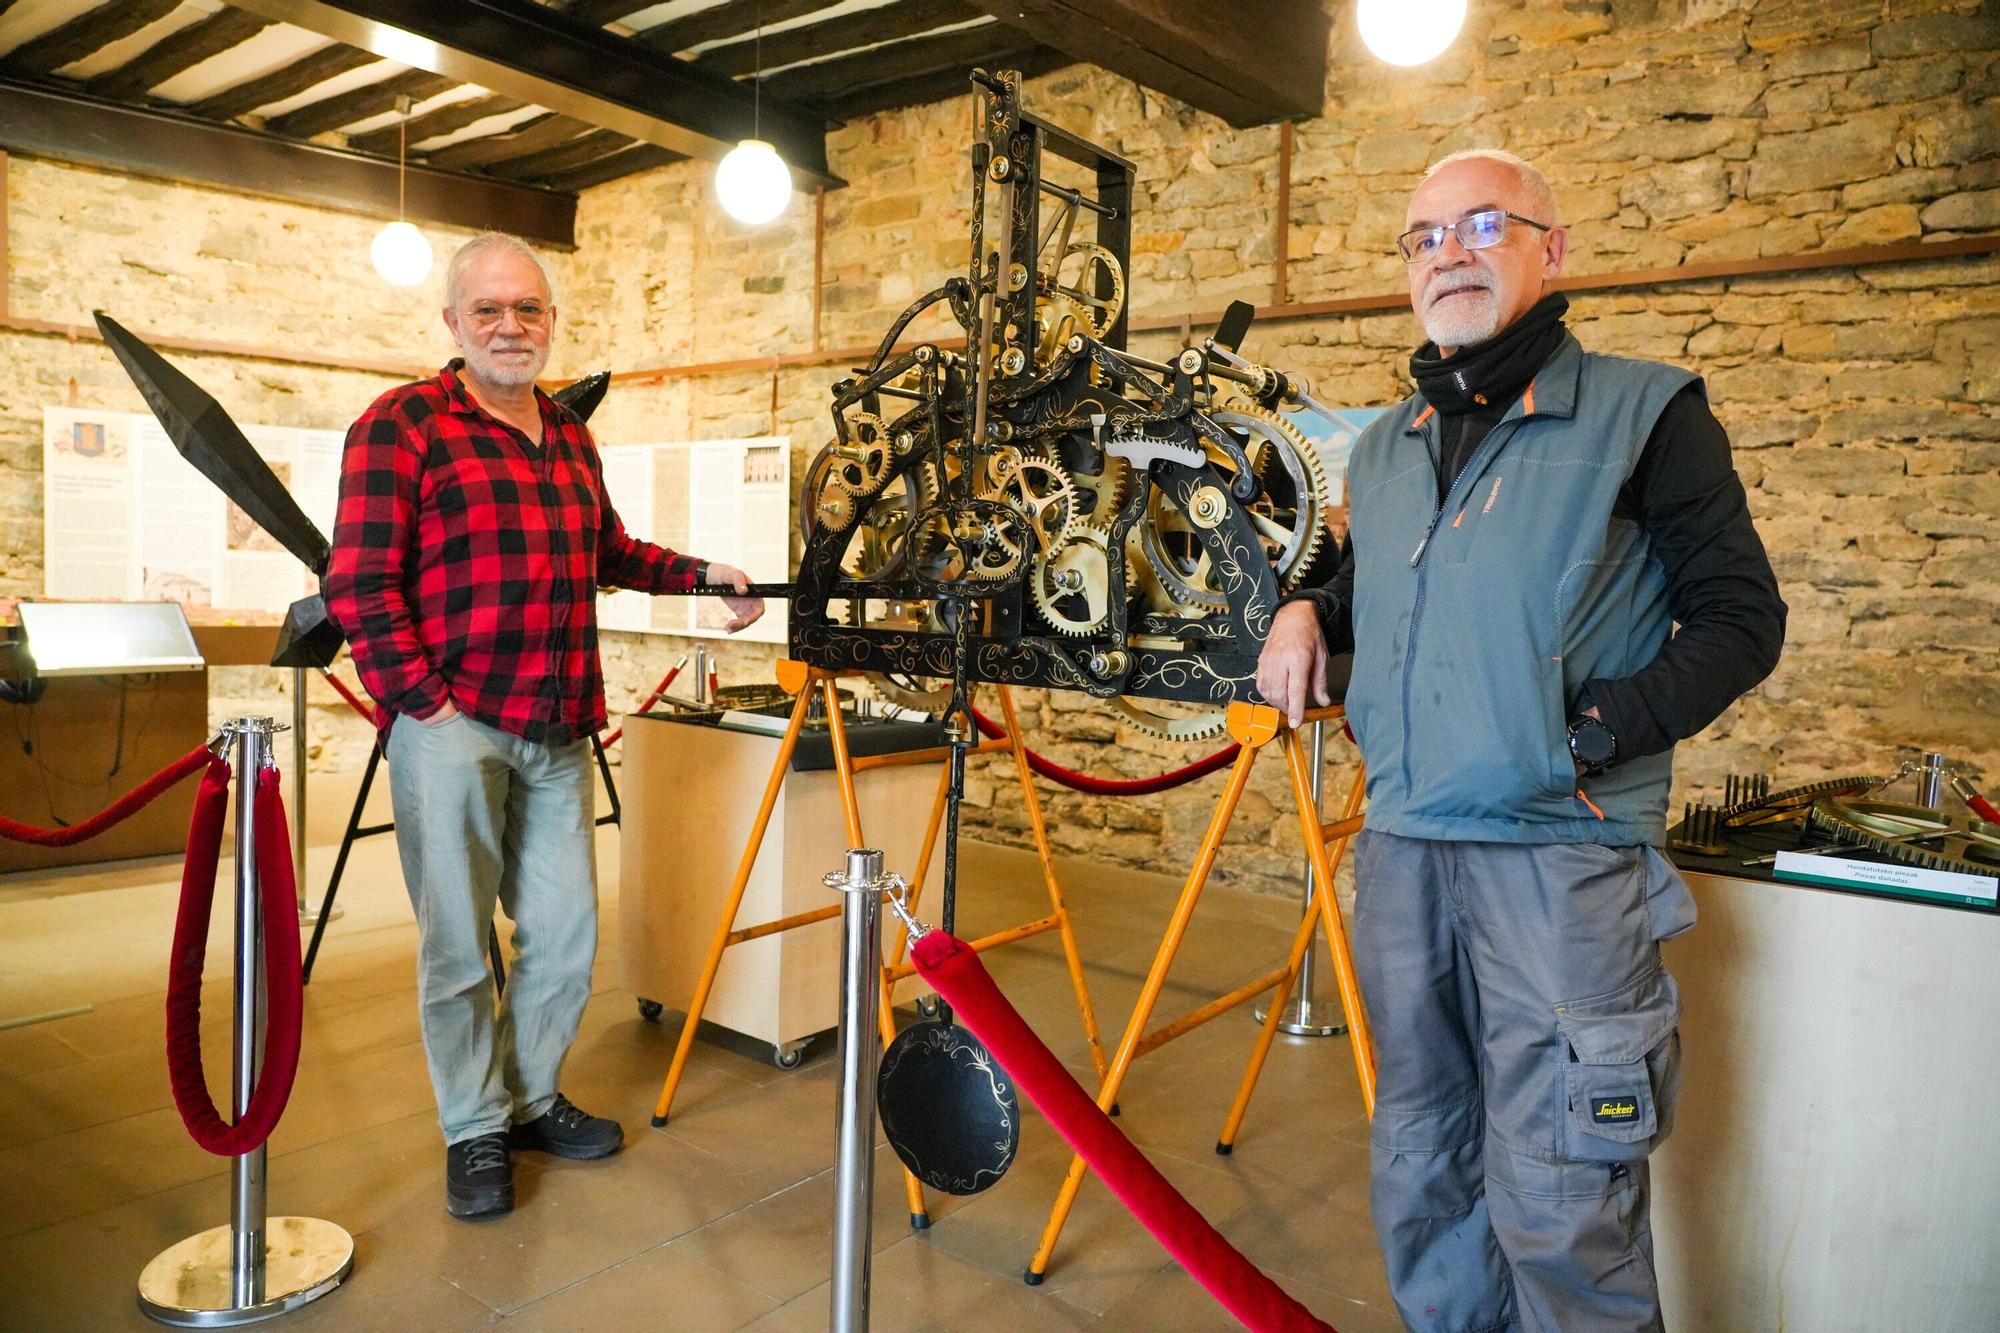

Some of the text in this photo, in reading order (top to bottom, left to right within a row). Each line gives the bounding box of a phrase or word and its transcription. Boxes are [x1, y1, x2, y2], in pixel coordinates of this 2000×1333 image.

[1847, 864, 1893, 874] Hondatutako
[1855, 872, 1876, 880] Piezas
[1596, 1102, 1635, 1116] Snickers
